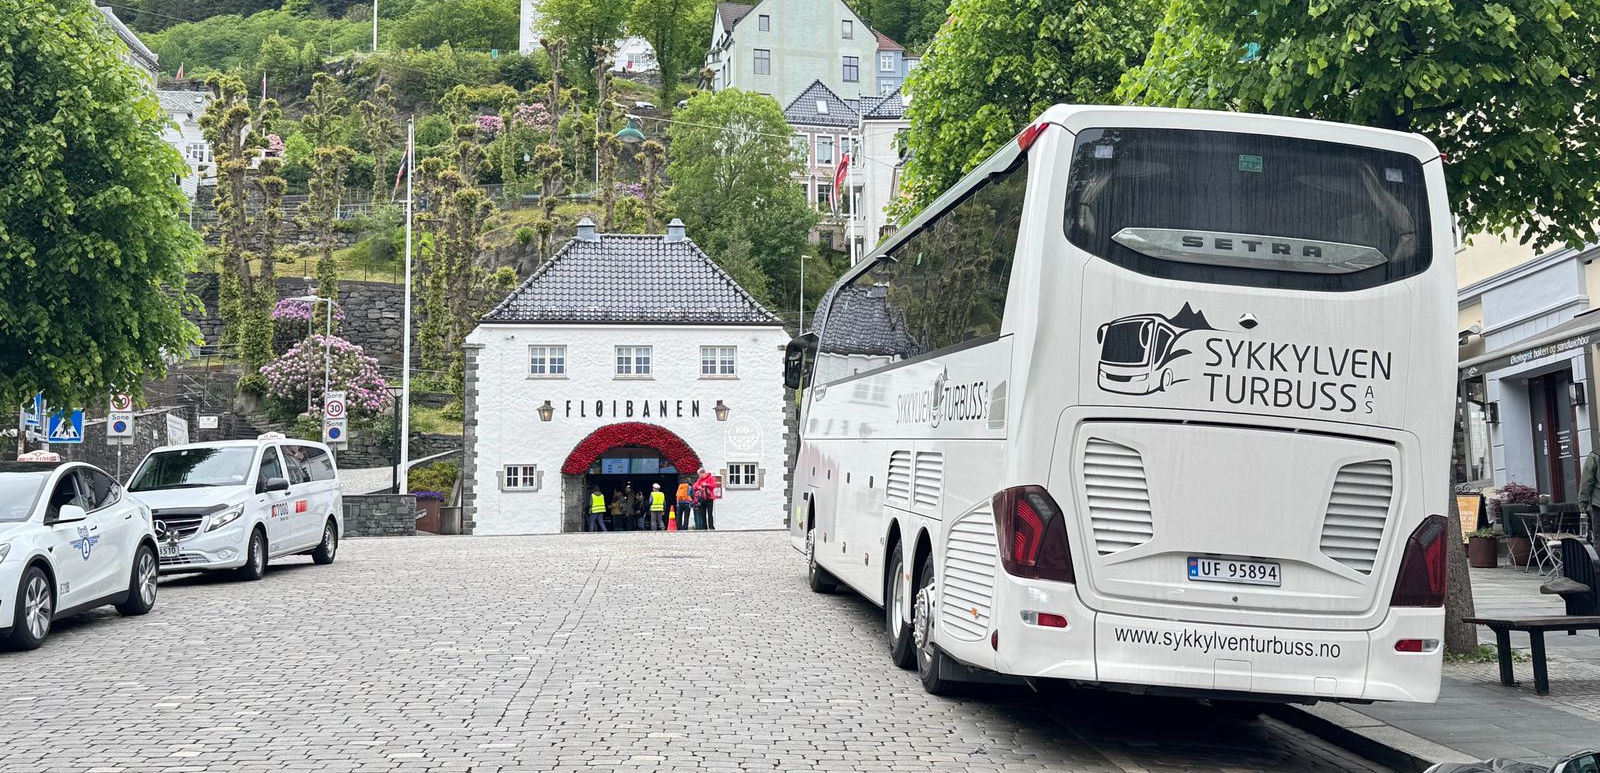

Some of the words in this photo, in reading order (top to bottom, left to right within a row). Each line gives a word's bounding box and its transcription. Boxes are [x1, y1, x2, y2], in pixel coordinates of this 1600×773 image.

[1182, 235, 1323, 258] SETRA
[1205, 337, 1392, 381] SYKKYLVEN
[944, 381, 984, 421] TURBUSS
[1203, 372, 1357, 413] TURBUSS
[329, 404, 341, 413] 30
[566, 400, 700, 418] FLØIBANEN
[1201, 560, 1221, 577] UF
[1228, 562, 1278, 581] 95894
[1114, 626, 1342, 659] www.sykkylventurbuss.no
